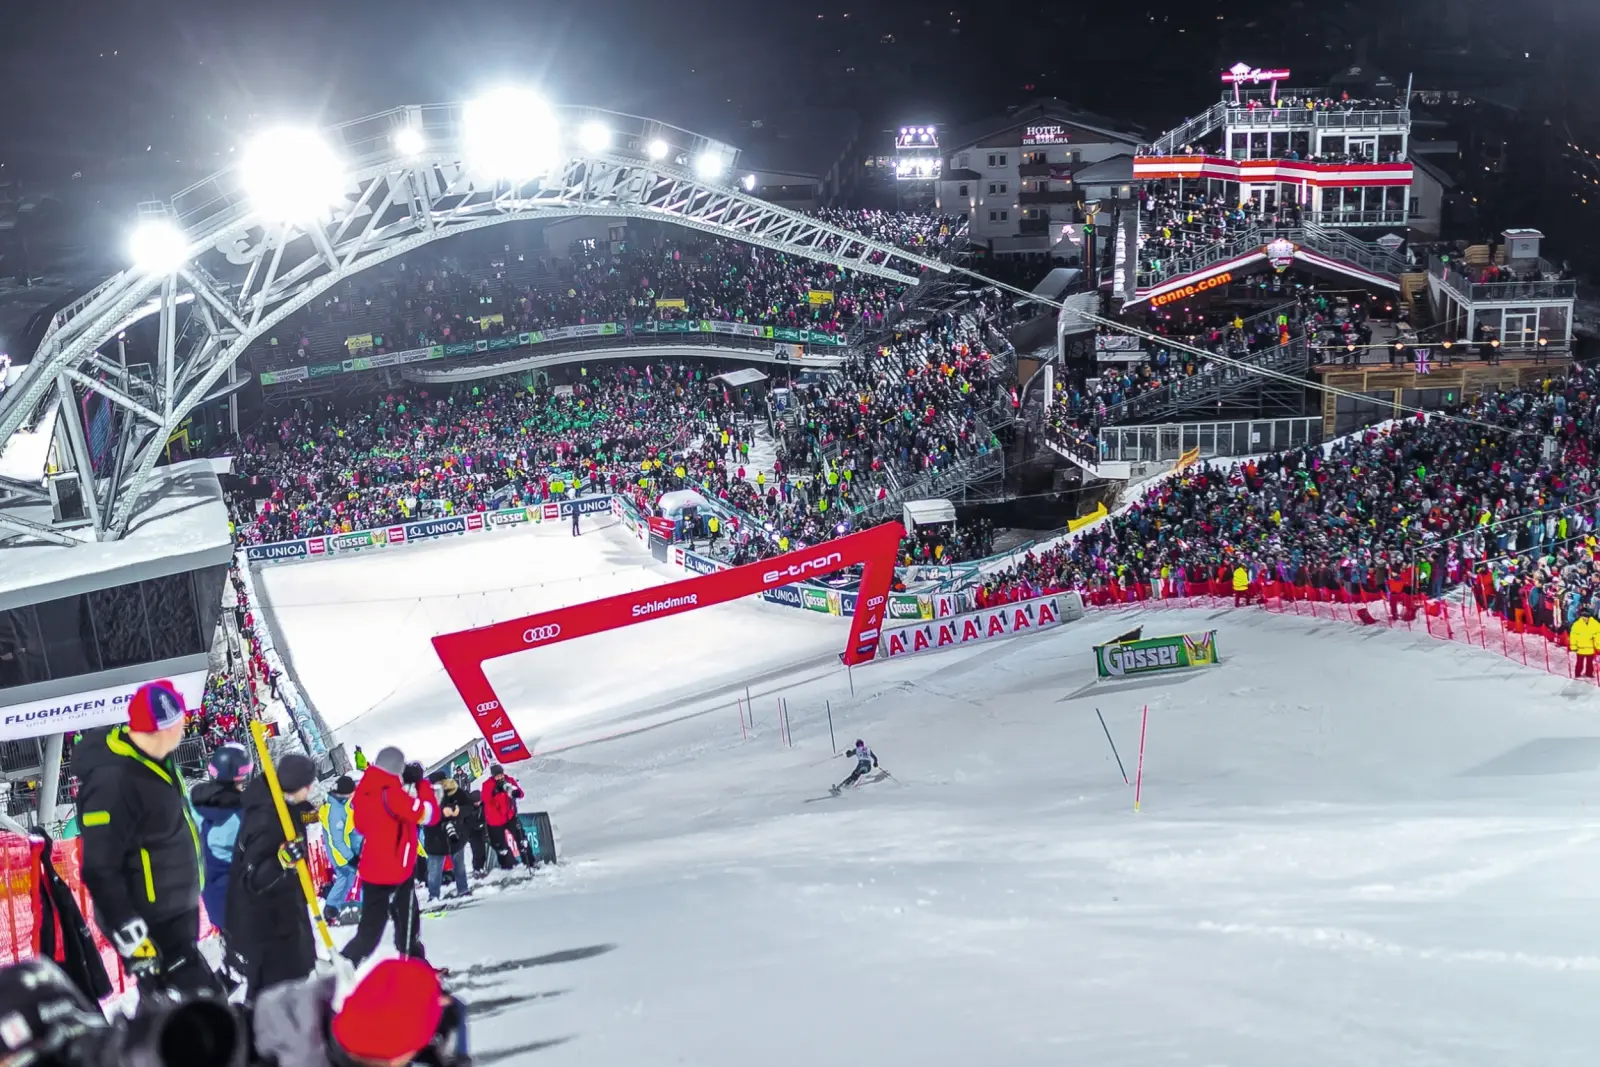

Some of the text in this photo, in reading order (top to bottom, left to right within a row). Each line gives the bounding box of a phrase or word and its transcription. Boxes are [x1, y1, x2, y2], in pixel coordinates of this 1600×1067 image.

[1026, 126, 1065, 136] HOTEL
[1150, 272, 1233, 307] tenne.com
[578, 499, 613, 513] UNIQA
[487, 512, 525, 526] Gösser
[426, 521, 464, 535] UNIQA
[330, 535, 369, 550] Gösser
[266, 545, 305, 558] UNIQA
[763, 552, 842, 584] e-tron
[774, 588, 800, 604] UNIQA
[803, 592, 827, 608] Gösser
[632, 594, 697, 617] Schladming
[889, 597, 918, 617] Gösser
[1103, 644, 1179, 676] Gösser
[5, 693, 134, 725] FLUGHAFEN GR
